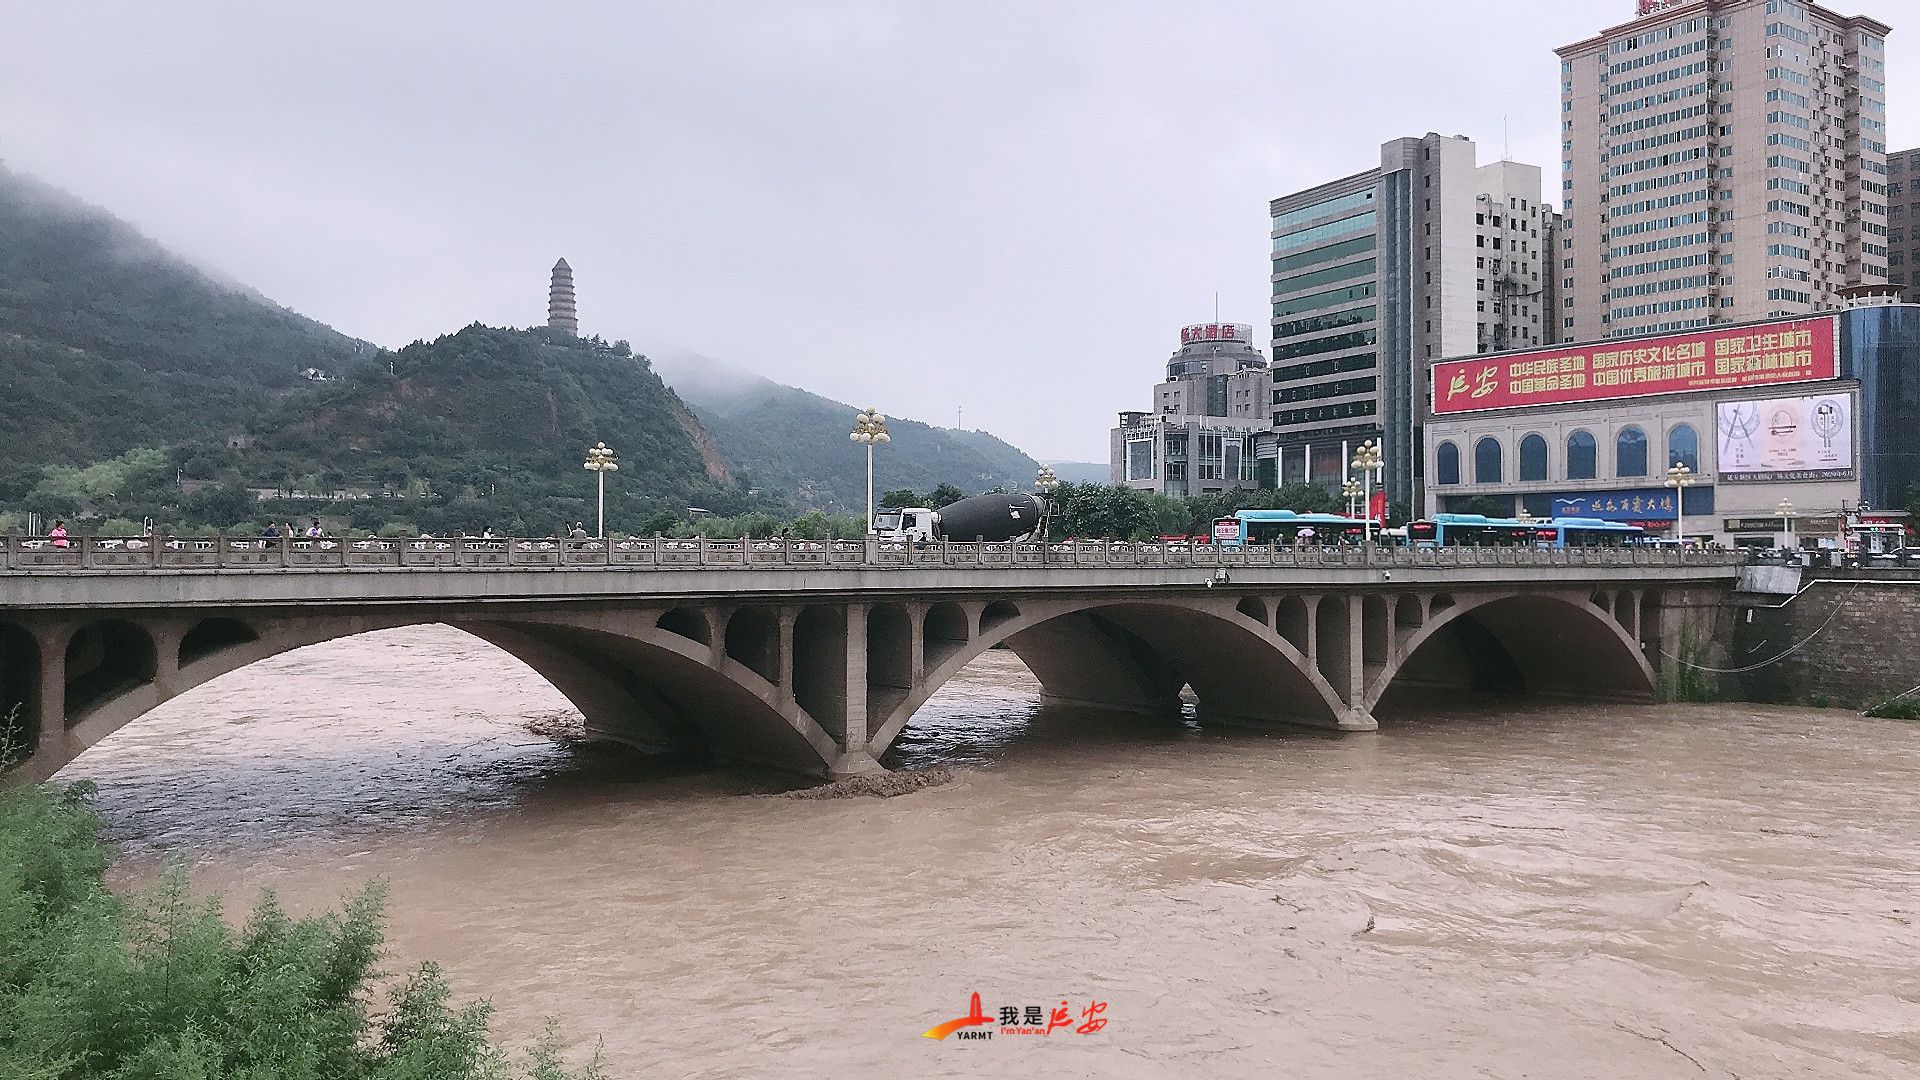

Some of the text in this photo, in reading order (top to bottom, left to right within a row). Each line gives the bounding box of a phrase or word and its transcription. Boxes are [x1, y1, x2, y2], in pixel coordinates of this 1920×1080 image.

[1509, 330, 1812, 377] 中华民族圣地 国家历史文化名城 国家卫生城市
[1509, 373, 1586, 394] 中国革命圣地
[1593, 360, 1706, 386] 中国优秀旅游城市
[1715, 350, 1812, 375] 国家森林城市
[1447, 366, 1499, 401] 延安
